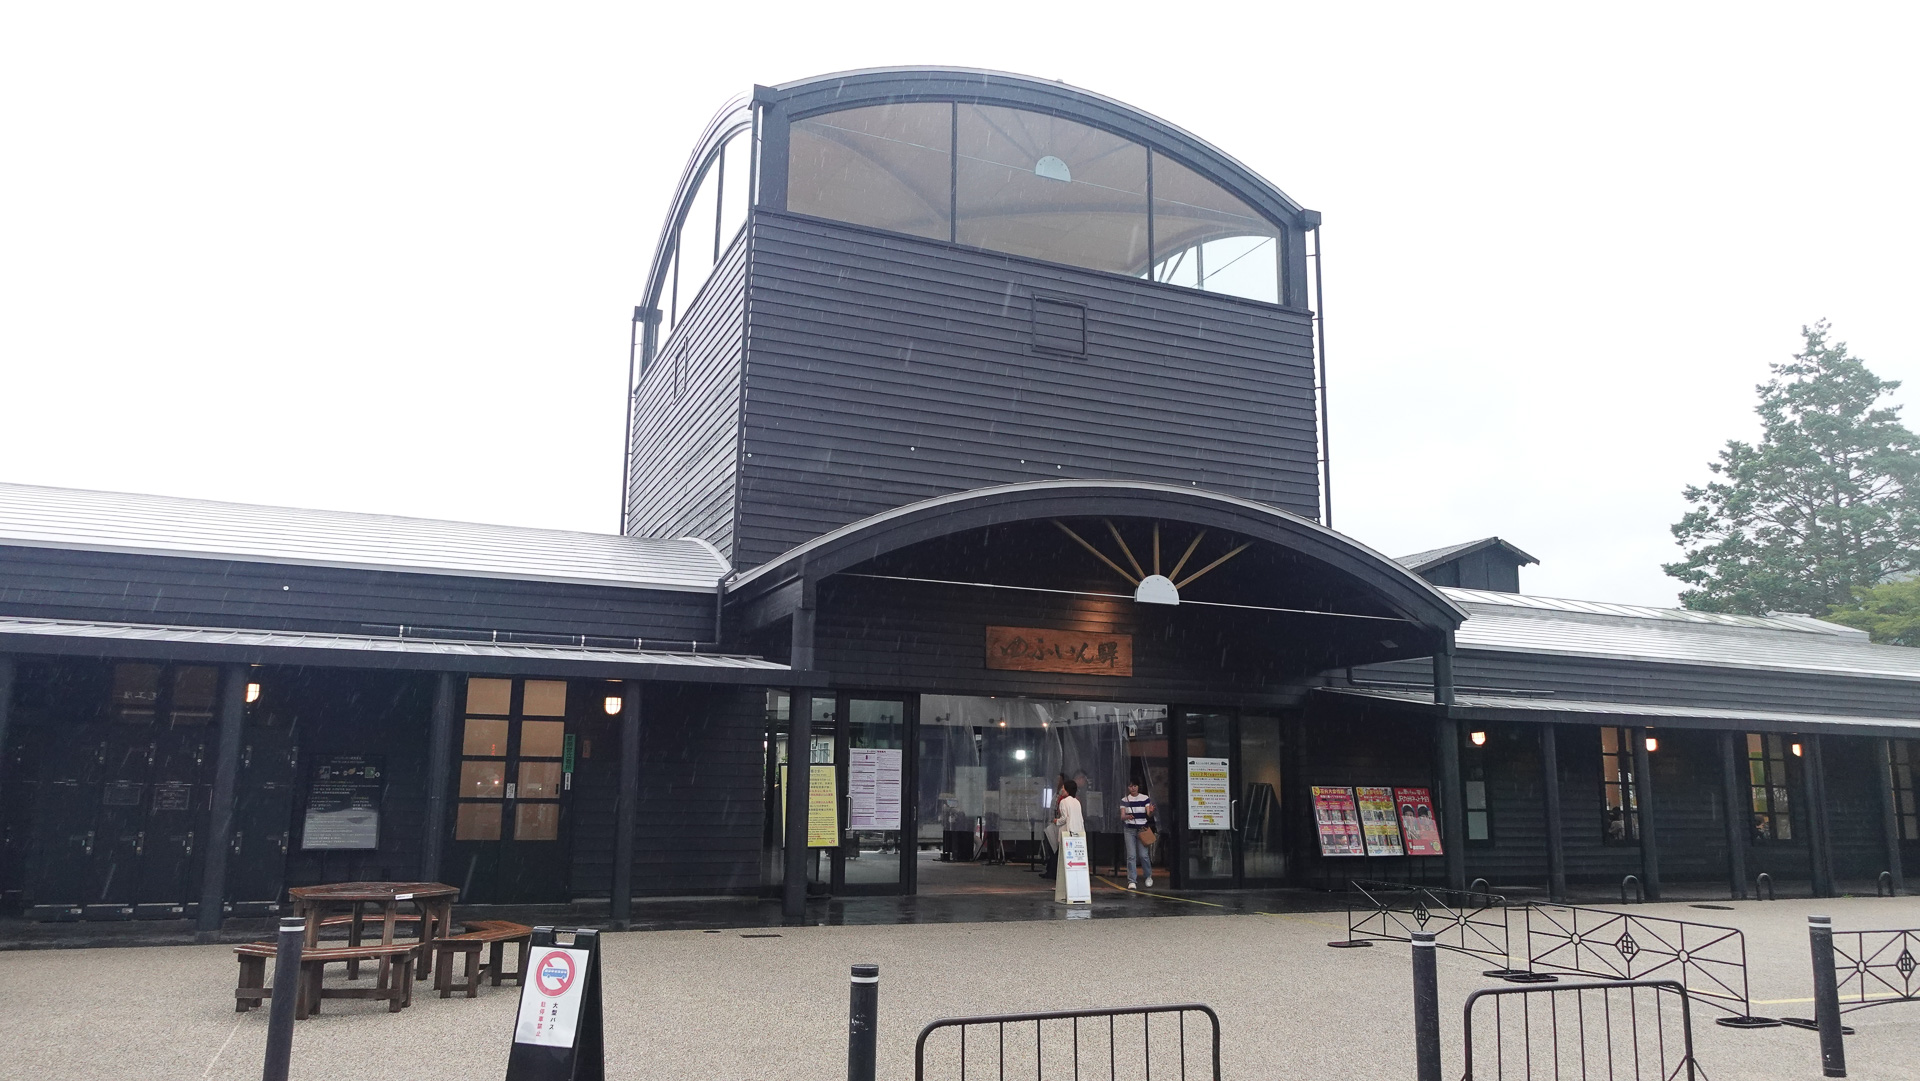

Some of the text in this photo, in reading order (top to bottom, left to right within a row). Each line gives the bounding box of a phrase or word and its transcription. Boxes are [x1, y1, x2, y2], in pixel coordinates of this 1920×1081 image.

[535, 1001, 546, 1037] 駐停車禁止
[549, 1002, 559, 1030] 大型バス
